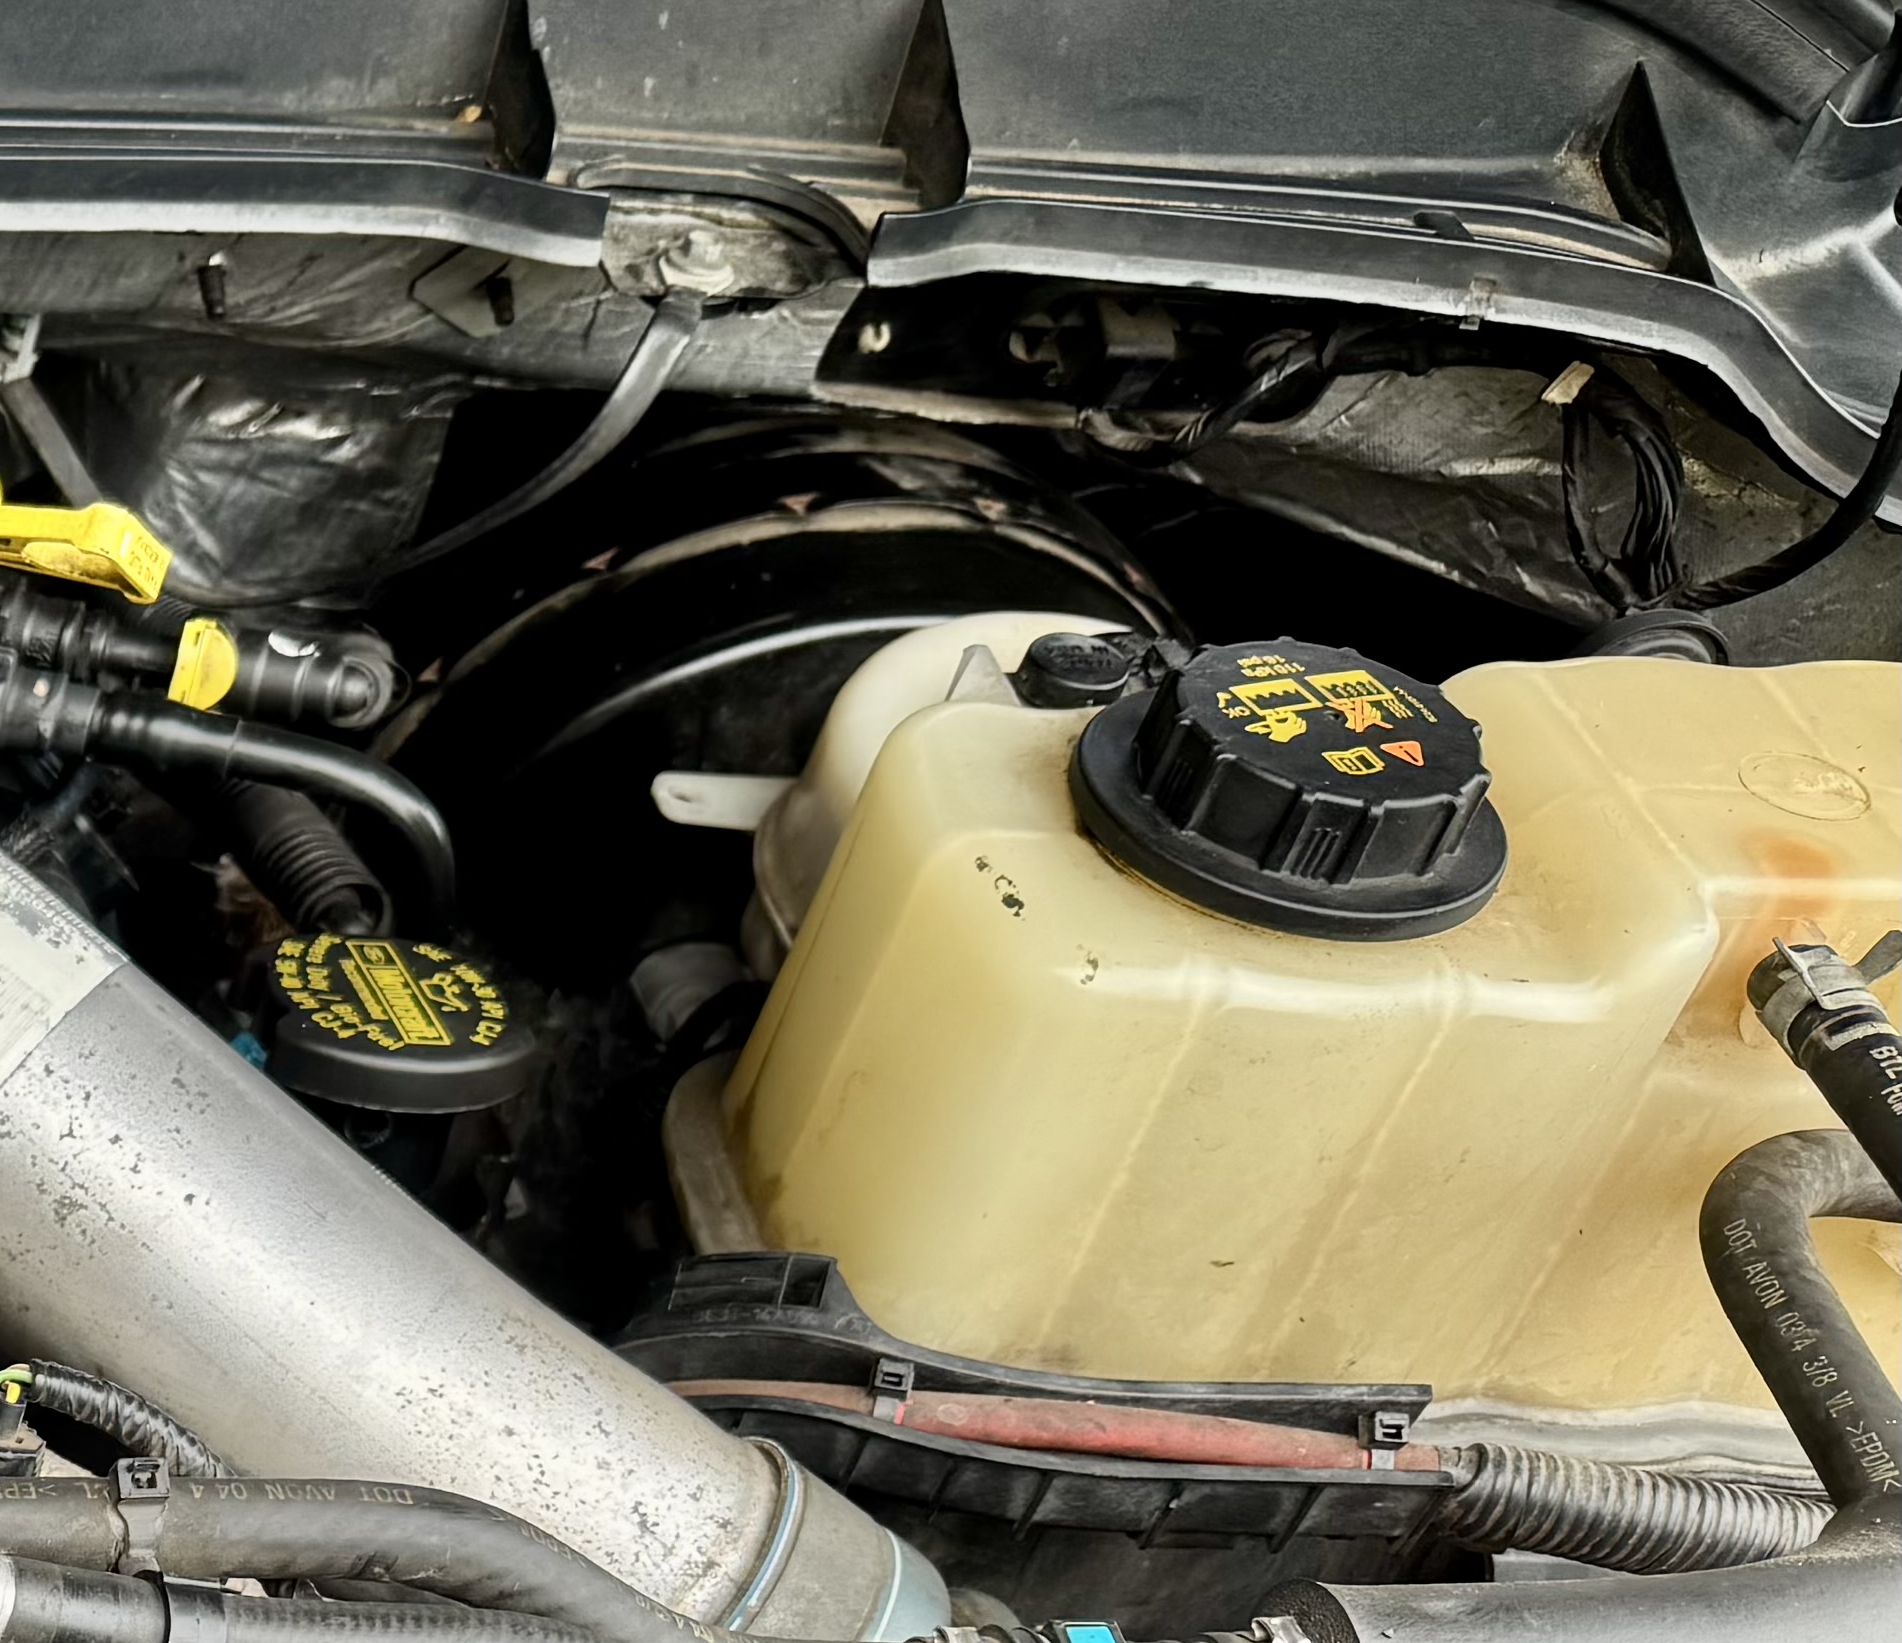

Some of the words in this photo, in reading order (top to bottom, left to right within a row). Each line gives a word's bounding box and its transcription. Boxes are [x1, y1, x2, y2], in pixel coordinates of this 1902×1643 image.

[1221, 704, 1251, 719] OK
[368, 967, 441, 1042] Motorcraft
[1722, 1217, 1758, 1256] DOT
[1741, 1259, 1790, 1310] AVON
[1801, 1355, 1838, 1389] 3/8
[1825, 1389, 1855, 1418] VL
[264, 1483, 337, 1501] AVON
[359, 1483, 415, 1505] DOT
